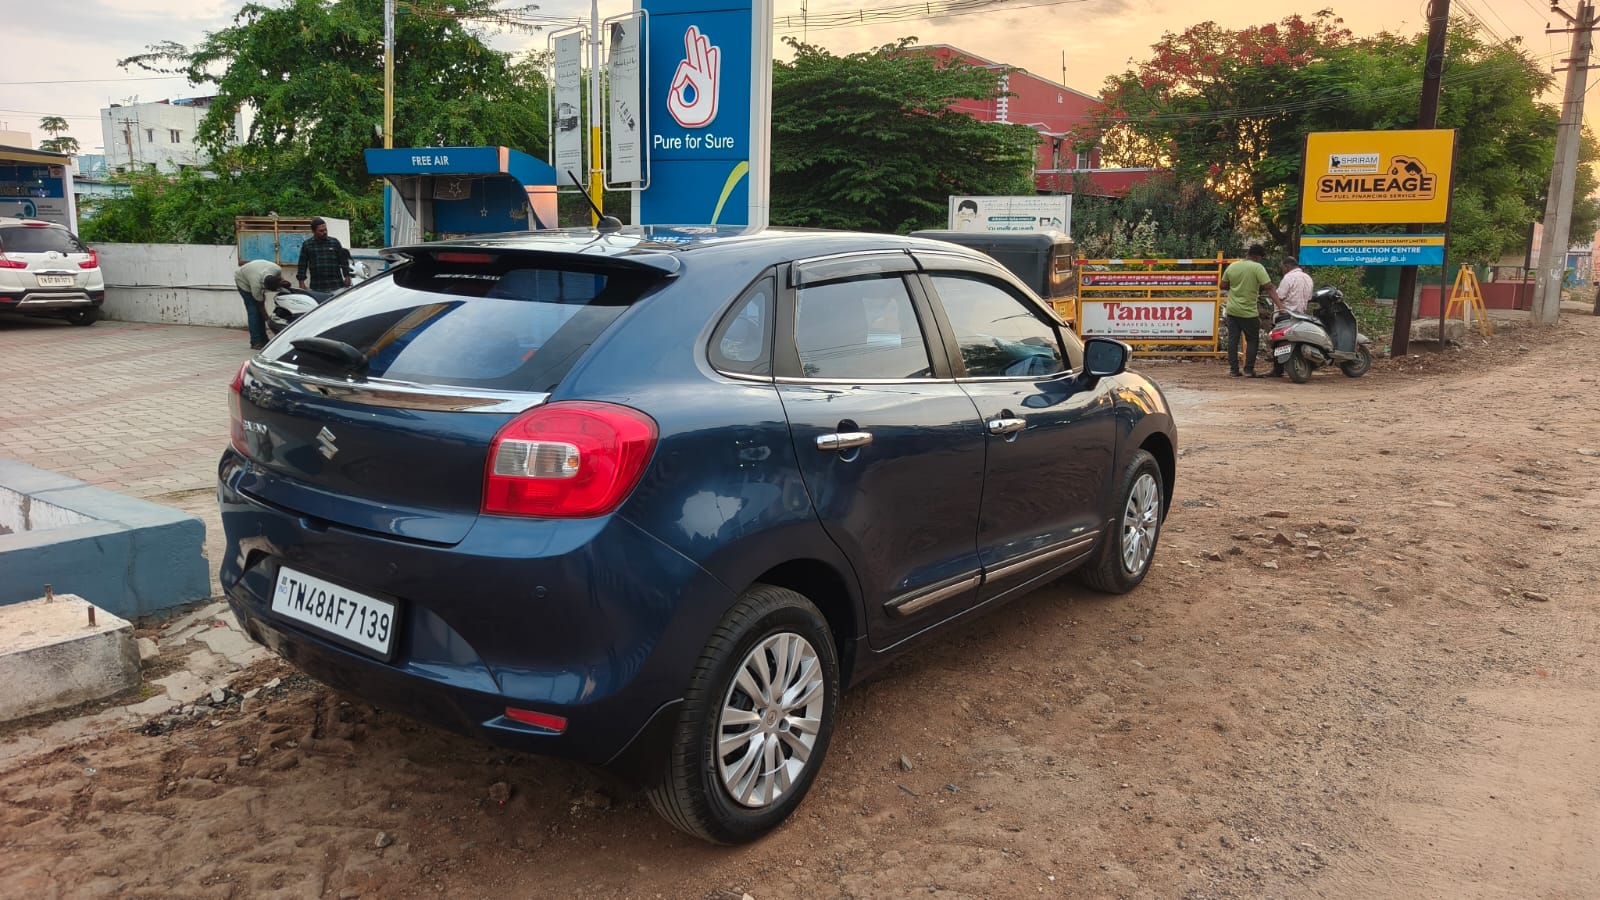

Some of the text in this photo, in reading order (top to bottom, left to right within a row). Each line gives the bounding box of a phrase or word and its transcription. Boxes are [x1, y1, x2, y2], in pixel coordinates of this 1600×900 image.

[654, 133, 735, 149] Pure for Sure
[411, 155, 449, 166] FREE AIR
[1341, 156, 1378, 164] SHRIRAM
[1321, 177, 1432, 193] SMILEAGE
[1392, 246, 1421, 254] CENTRE
[1103, 302, 1192, 321] Tanura
[287, 578, 390, 643] TN48AF7139
